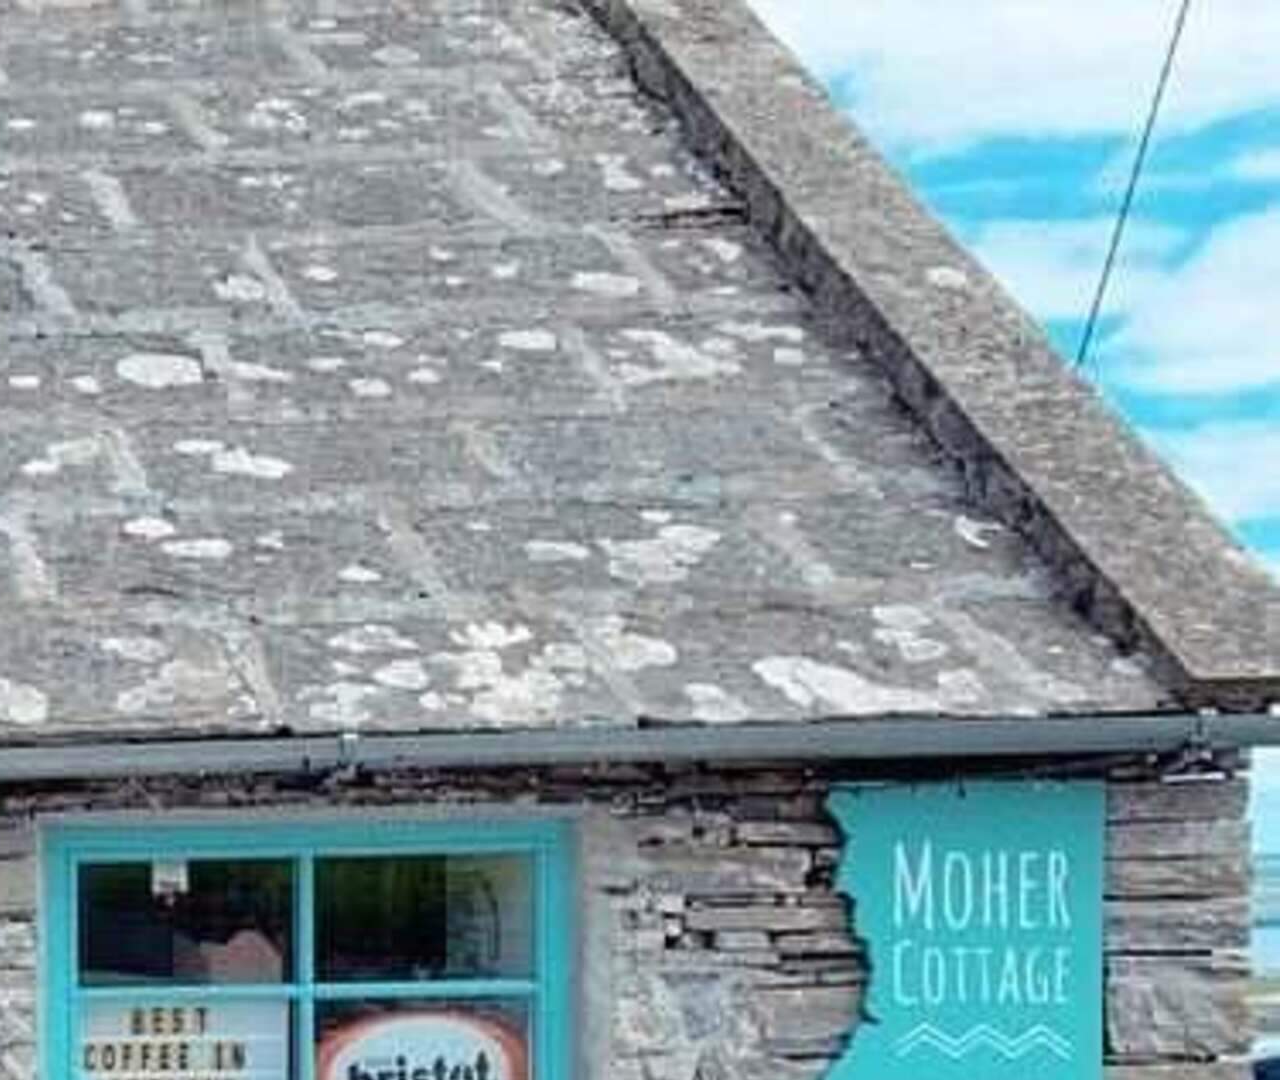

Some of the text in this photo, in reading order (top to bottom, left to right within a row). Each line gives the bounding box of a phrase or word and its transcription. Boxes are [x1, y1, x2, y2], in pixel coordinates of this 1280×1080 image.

[892, 838, 1072, 930] MOHER
[891, 938, 1073, 1004] COTTAGE
[131, 1007, 207, 1035] BEST
[83, 1040, 246, 1070] COFFEE IN
